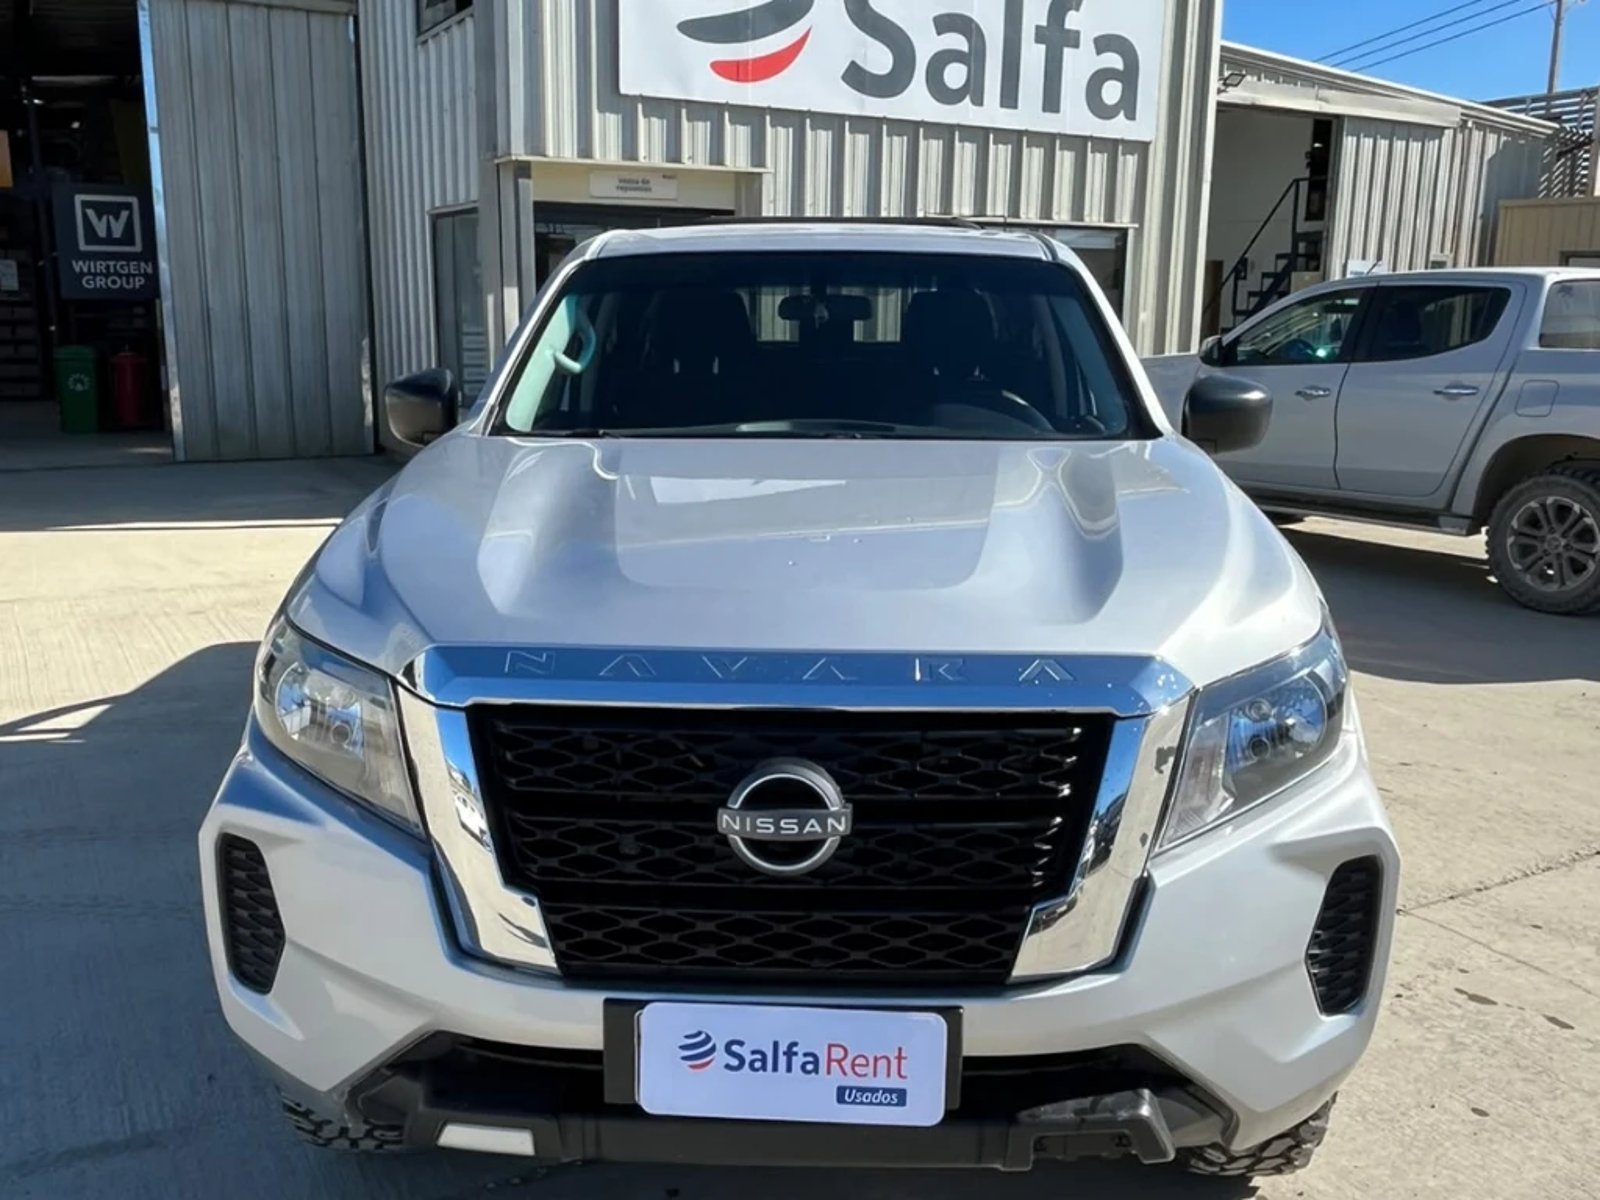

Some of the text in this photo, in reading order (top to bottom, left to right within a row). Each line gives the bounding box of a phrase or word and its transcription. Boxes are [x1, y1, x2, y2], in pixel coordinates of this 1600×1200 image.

[841, 0, 1139, 121] Salfa
[71, 260, 153, 274] WIRTGEN
[82, 275, 145, 289] GROUP
[503, 649, 1076, 682] NAVARA
[722, 813, 846, 834] NISSAN
[723, 1039, 908, 1079] SalfaRent
[844, 1088, 899, 1105] Usados
